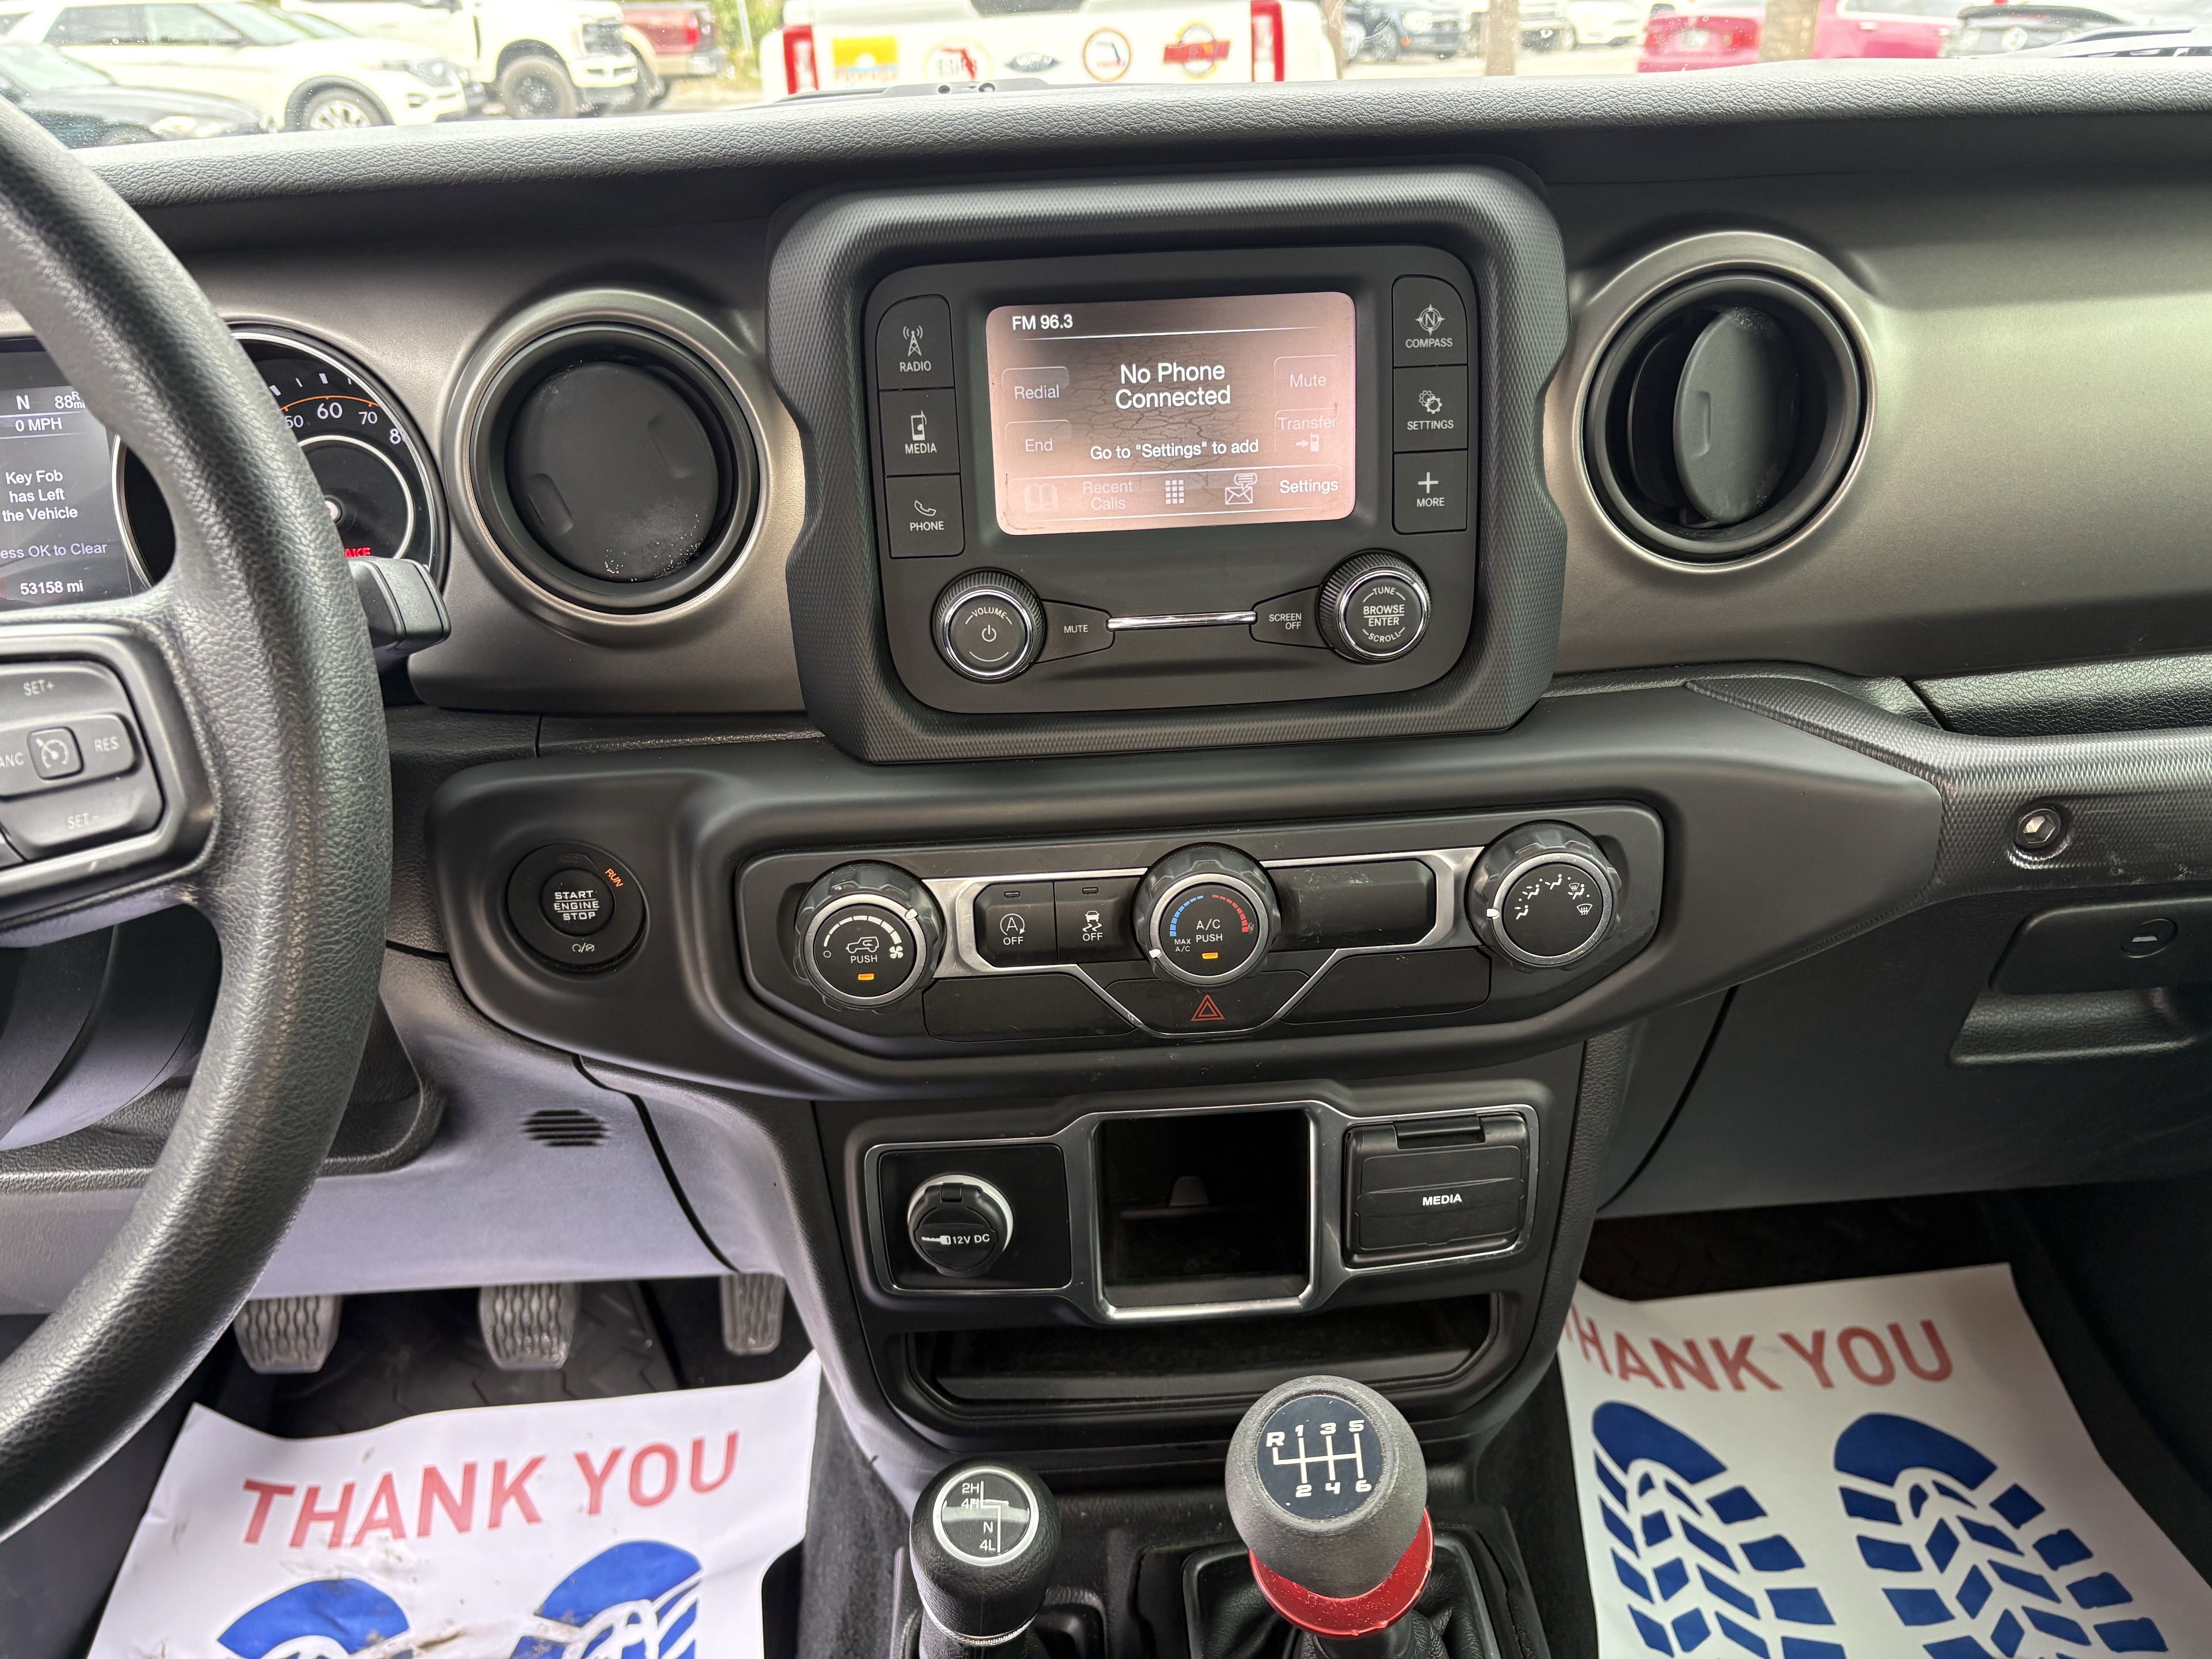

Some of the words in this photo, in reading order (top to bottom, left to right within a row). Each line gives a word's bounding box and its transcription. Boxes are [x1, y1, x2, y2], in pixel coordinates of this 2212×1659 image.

[1012, 316, 1036, 330] FM
[1041, 314, 1073, 329] 96.3
[1406, 338, 1453, 349] COMPASS
[900, 361, 931, 372] RADIO
[1121, 364, 1150, 384] No
[1158, 362, 1225, 382] Phone
[1290, 374, 1326, 388] Mute
[1014, 385, 1060, 399] Redial
[1115, 385, 1231, 409] Connected
[16, 395, 30, 410] N
[55, 395, 73, 409] 88
[317, 402, 342, 419] 60
[285, 415, 304, 428] 50
[359, 411, 378, 424] 70
[1278, 415, 1337, 430] Transfer
[15, 420, 24, 431] 0
[28, 417, 62, 431] MPH
[1407, 420, 1454, 430] SETTINGS
[905, 442, 937, 454] MEDIA
[1025, 438, 1053, 452] End
[1090, 446, 1112, 460] Go
[1116, 445, 1131, 459] to
[1136, 441, 1207, 459] "Settings"
[1212, 442, 1227, 454] to
[1231, 439, 1259, 453] add
[6, 471, 32, 486] Key
[36, 470, 63, 483] Fob
[1083, 480, 1133, 494] Recent
[1280, 479, 1339, 495] Settings
[9, 490, 35, 503] has
[39, 488, 65, 501] Left
[1091, 497, 1126, 510] Calls
[1417, 497, 1445, 507] MORE
[2, 510, 24, 522] the
[26, 507, 79, 520] Vehicle
[910, 521, 944, 532] PHONE
[28, 545, 51, 557] OK
[53, 544, 66, 556] to
[70, 543, 107, 555] Clear
[20, 581, 63, 595] 53158
[67, 580, 84, 592] mi
[1372, 586, 1396, 596] TUNE
[972, 607, 1007, 619] VOLUME
[1364, 604, 1405, 615] BROWSE
[1269, 613, 1302, 622] SCREEN
[1368, 617, 1400, 627] ENTER
[1064, 625, 1088, 634] MUTE
[1285, 622, 1301, 630] OFF
[1368, 632, 1401, 643] SCROLL
[94, 737, 120, 752] RES
[605, 868, 623, 888] RUN
[555, 890, 594, 900] START
[554, 900, 600, 911] ENGINE
[563, 912, 596, 921] STOP
[1196, 919, 1221, 930] A/C
[1003, 936, 1024, 945] OFF
[1082, 933, 1103, 941] OFF
[1196, 933, 1223, 943] PUSH
[850, 955, 878, 963] PUSH
[1423, 1194, 1462, 1206] MEDIA
[952, 1236, 971, 1244] 12V
[974, 1234, 990, 1243] DC
[1778, 1319, 1953, 1388] YOU
[1266, 1431, 1285, 1447] R
[1295, 1424, 1304, 1436] 1
[1320, 1422, 1336, 1435] 3
[1349, 1420, 1364, 1432] 5
[242, 1455, 547, 1549] THANK
[573, 1430, 740, 1517] YOU
[962, 1482, 979, 1494] 2H
[1296, 1484, 1312, 1498] 2
[1325, 1482, 1340, 1494] 4
[1356, 1480, 1372, 1492] 6
[961, 1498, 979, 1509] 4H
[983, 1521, 993, 1533] N
[979, 1539, 996, 1551] 4L
